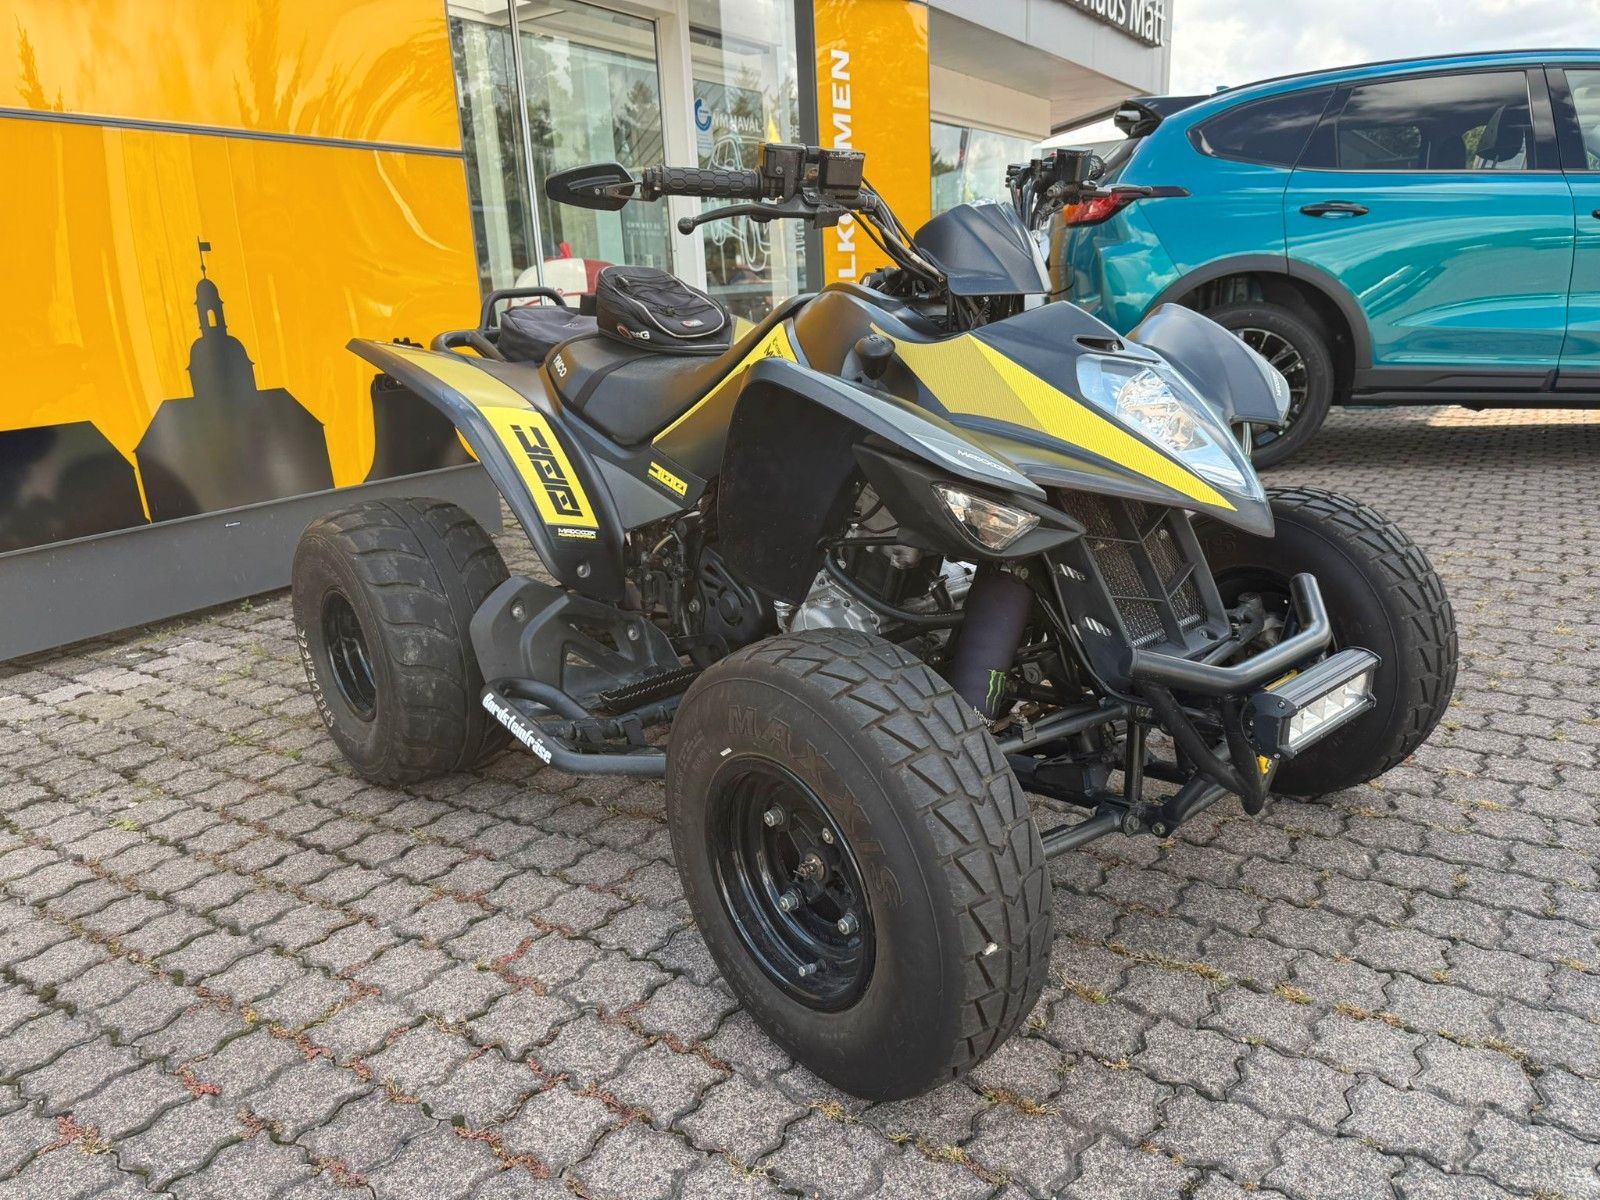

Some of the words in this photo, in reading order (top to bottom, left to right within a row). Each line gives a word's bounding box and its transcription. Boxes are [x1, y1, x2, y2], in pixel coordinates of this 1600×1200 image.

[1075, 0, 1126, 25] aus
[482, 692, 553, 765] Bordsteinfräse
[727, 704, 904, 909] MAXXIS
